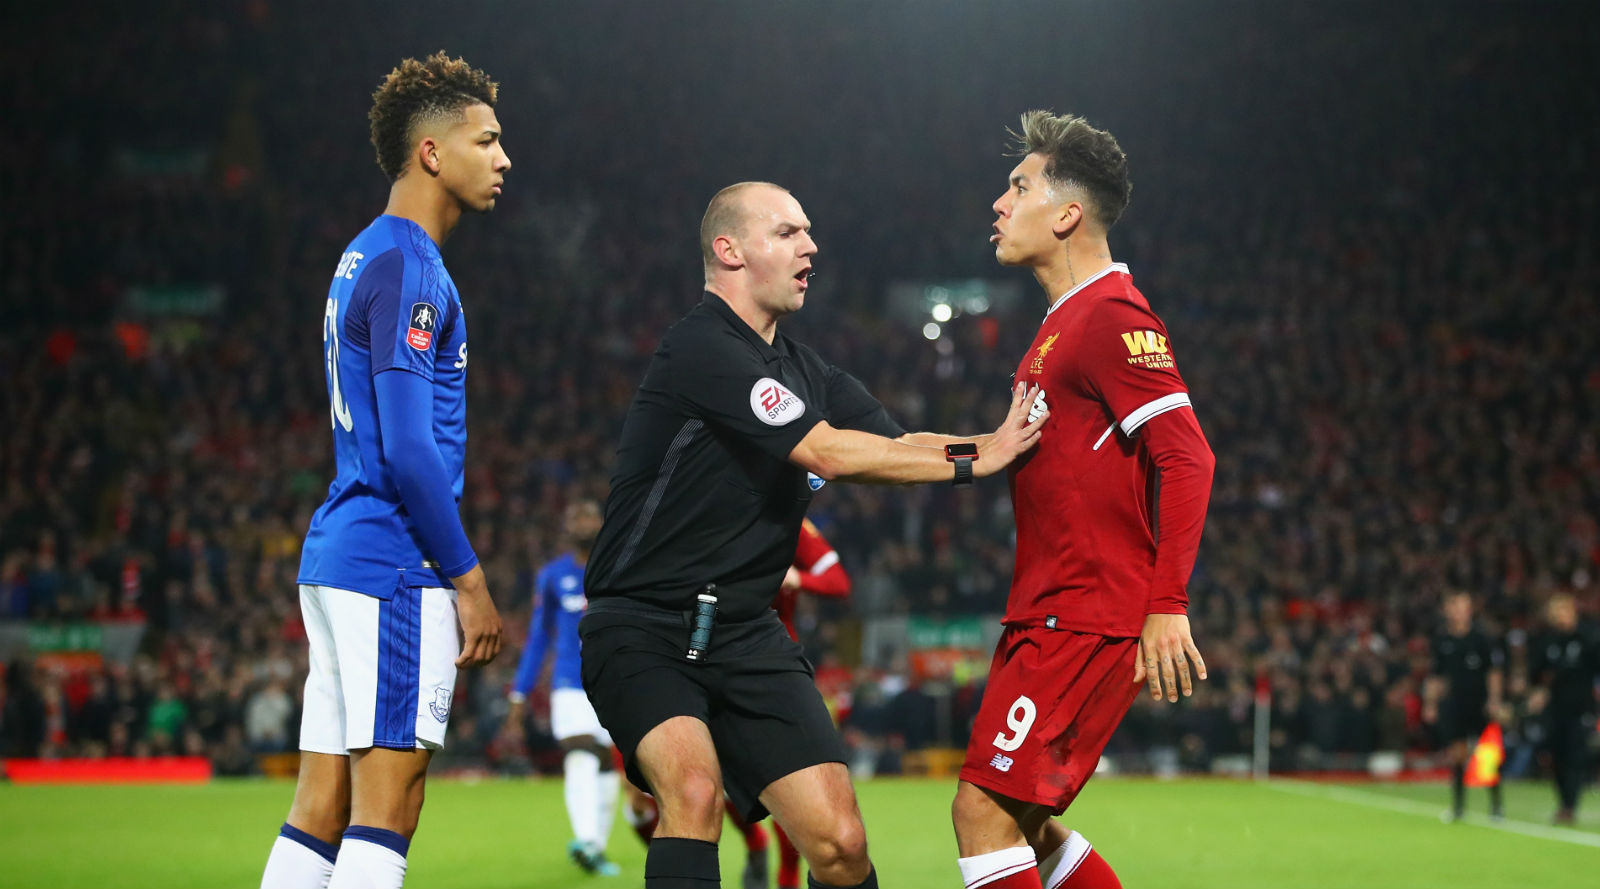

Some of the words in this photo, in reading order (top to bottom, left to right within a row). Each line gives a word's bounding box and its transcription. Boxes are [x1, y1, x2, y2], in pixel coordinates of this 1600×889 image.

[1121, 330, 1168, 356] WU
[1127, 354, 1173, 364] WESTERN
[760, 385, 793, 413] EA
[768, 396, 799, 420] SPORTS
[992, 695, 1037, 752] 9
